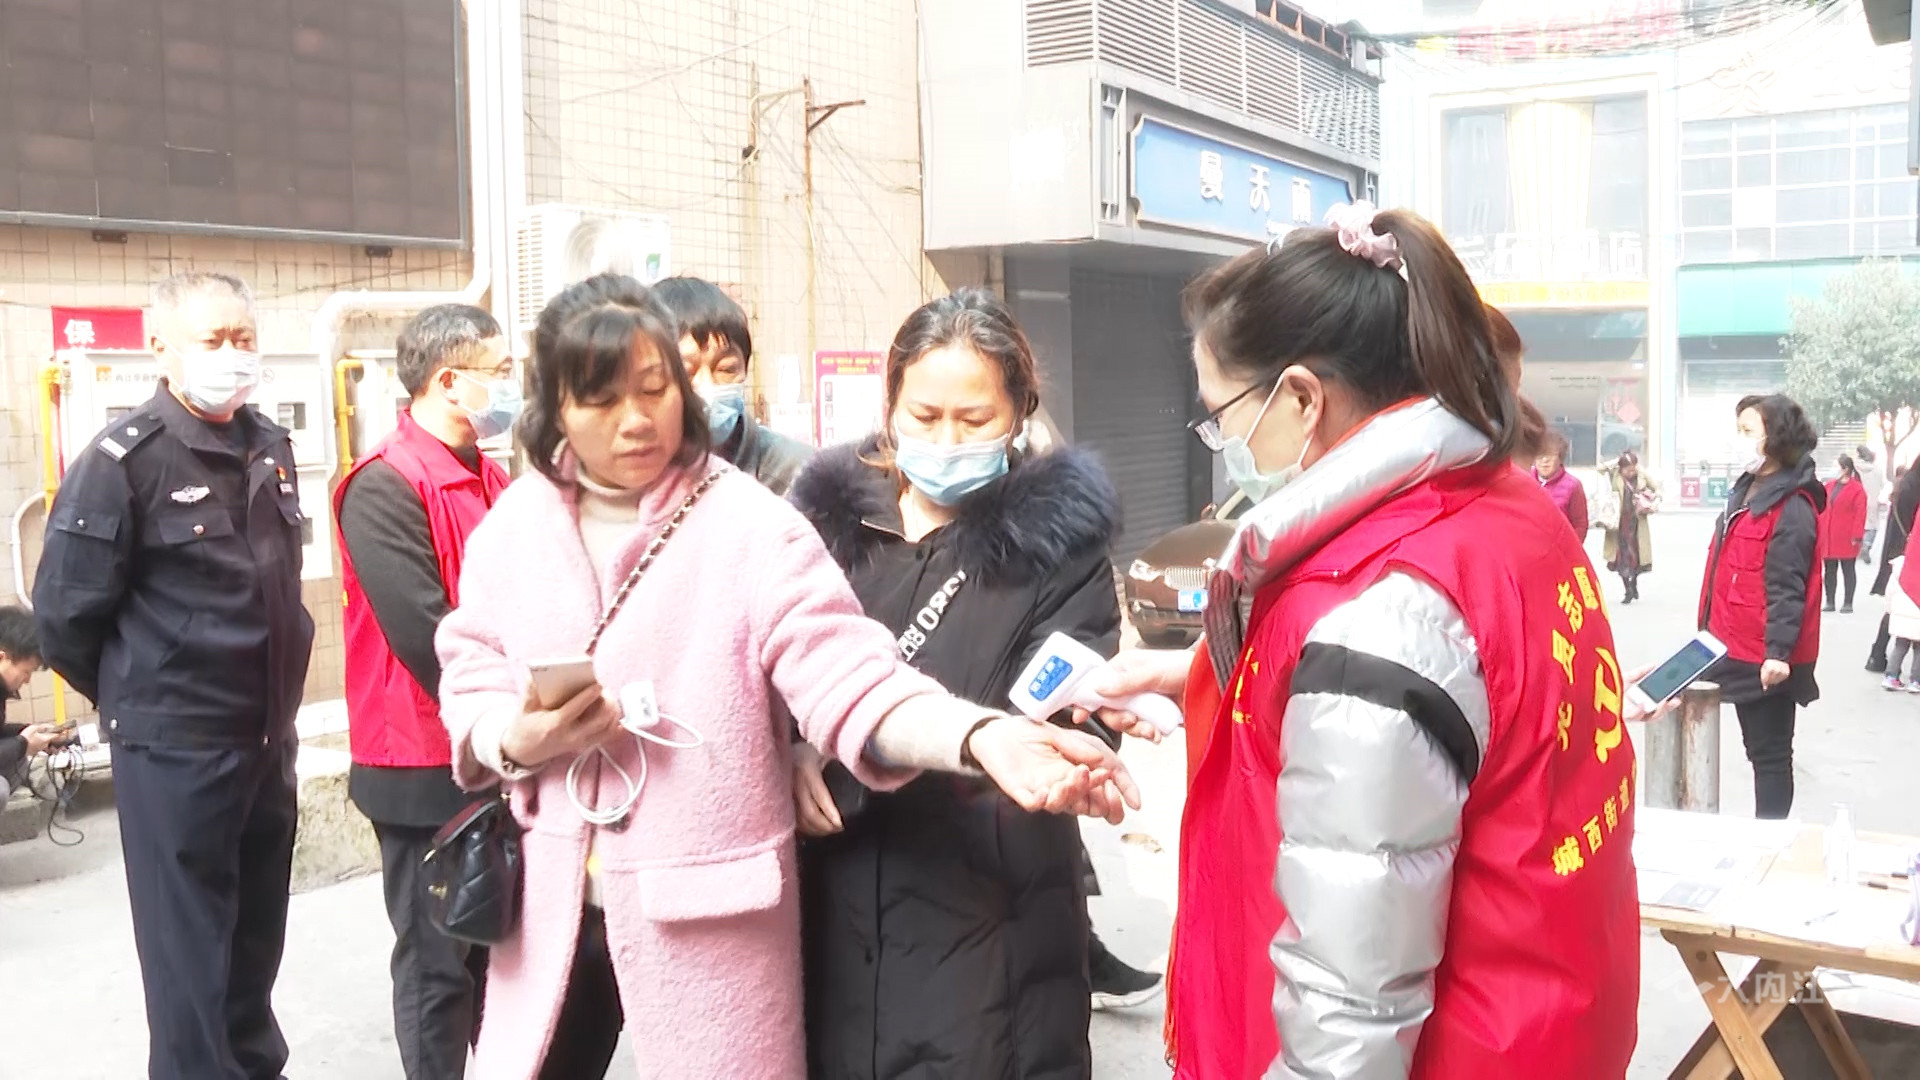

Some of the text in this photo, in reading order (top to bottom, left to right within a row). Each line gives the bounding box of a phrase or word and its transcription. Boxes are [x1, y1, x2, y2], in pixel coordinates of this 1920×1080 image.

[63, 318, 97, 345] 保
[1552, 761, 1637, 876] 城西街道
